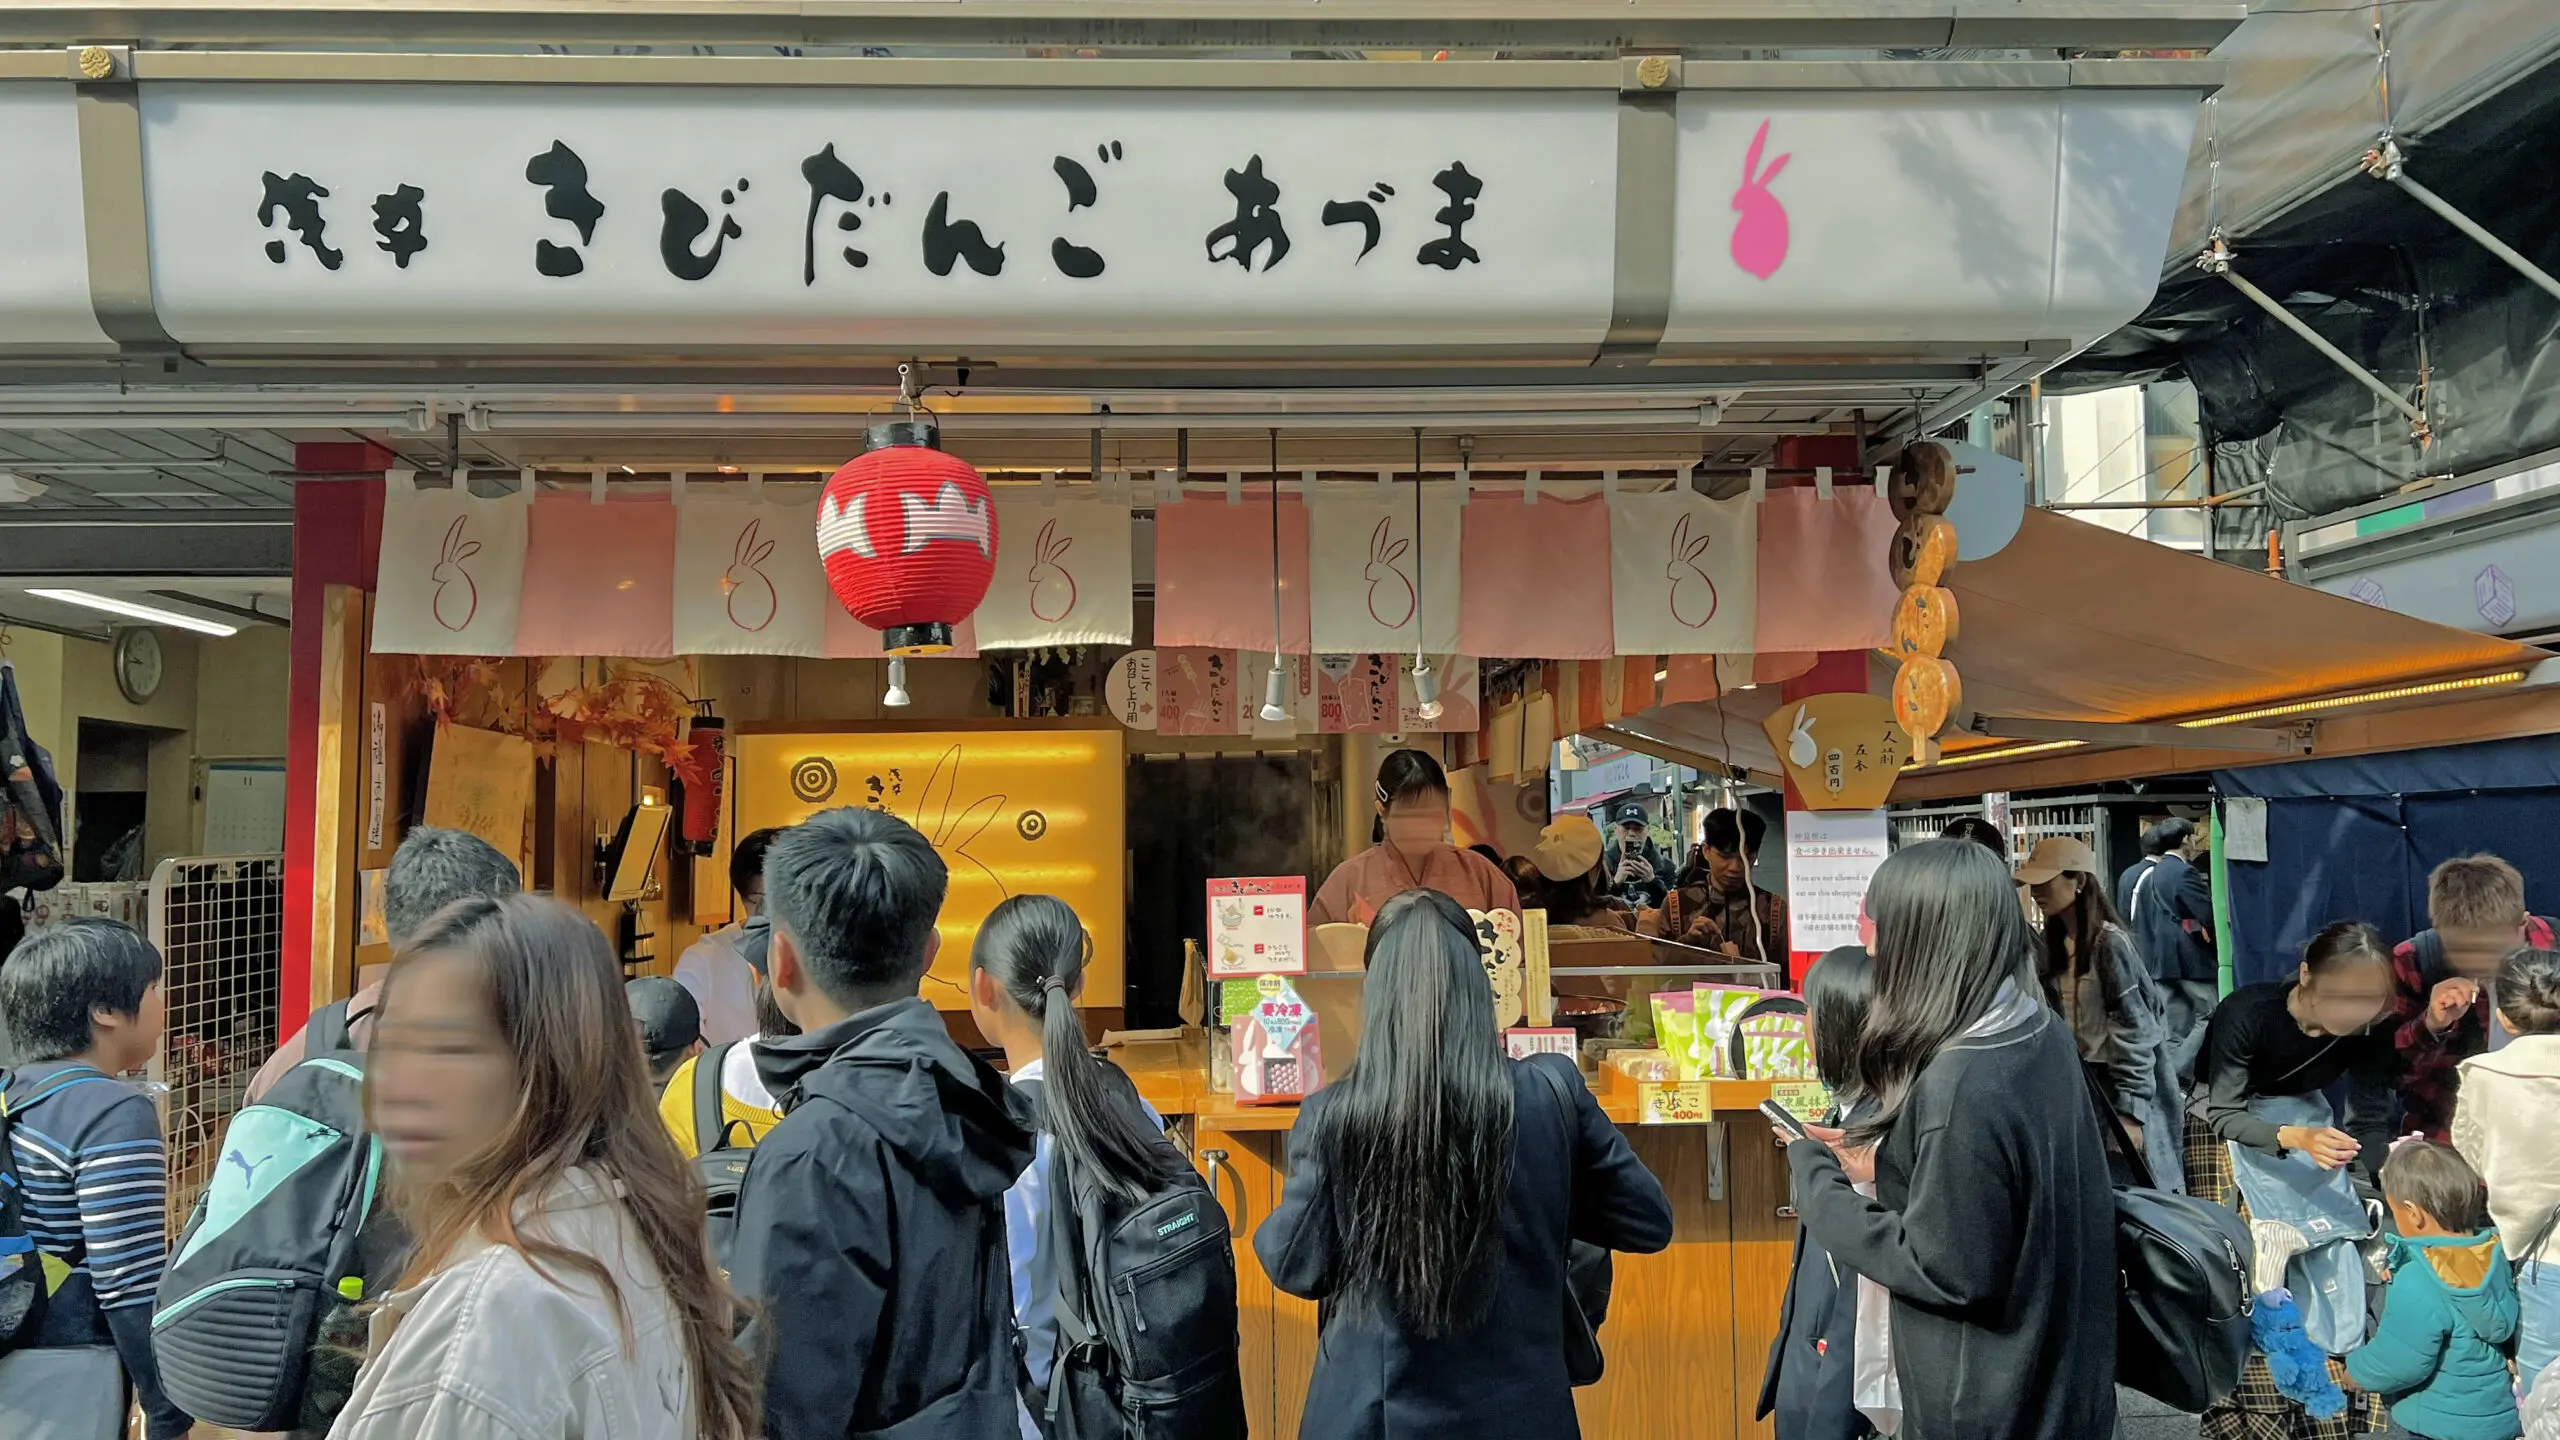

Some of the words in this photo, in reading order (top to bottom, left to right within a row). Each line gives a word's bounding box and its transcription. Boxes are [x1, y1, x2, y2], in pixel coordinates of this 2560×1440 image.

[526, 140, 1122, 286] きびだんご
[1206, 155, 1483, 272] あづま
[1141, 657, 1152, 691] ここで
[1126, 657, 1138, 723] お召し上り用
[1321, 703, 1342, 718] 800
[1854, 744, 1868, 772] 五本
[1881, 720, 1897, 765] 一人前
[1828, 753, 1840, 788] 四百円
[1796, 874, 1809, 882] You
[1835, 874, 1860, 882] allowed
[1262, 1003, 1302, 1017] 要冷凍
[1157, 1212, 1195, 1236] STRAIGHT
